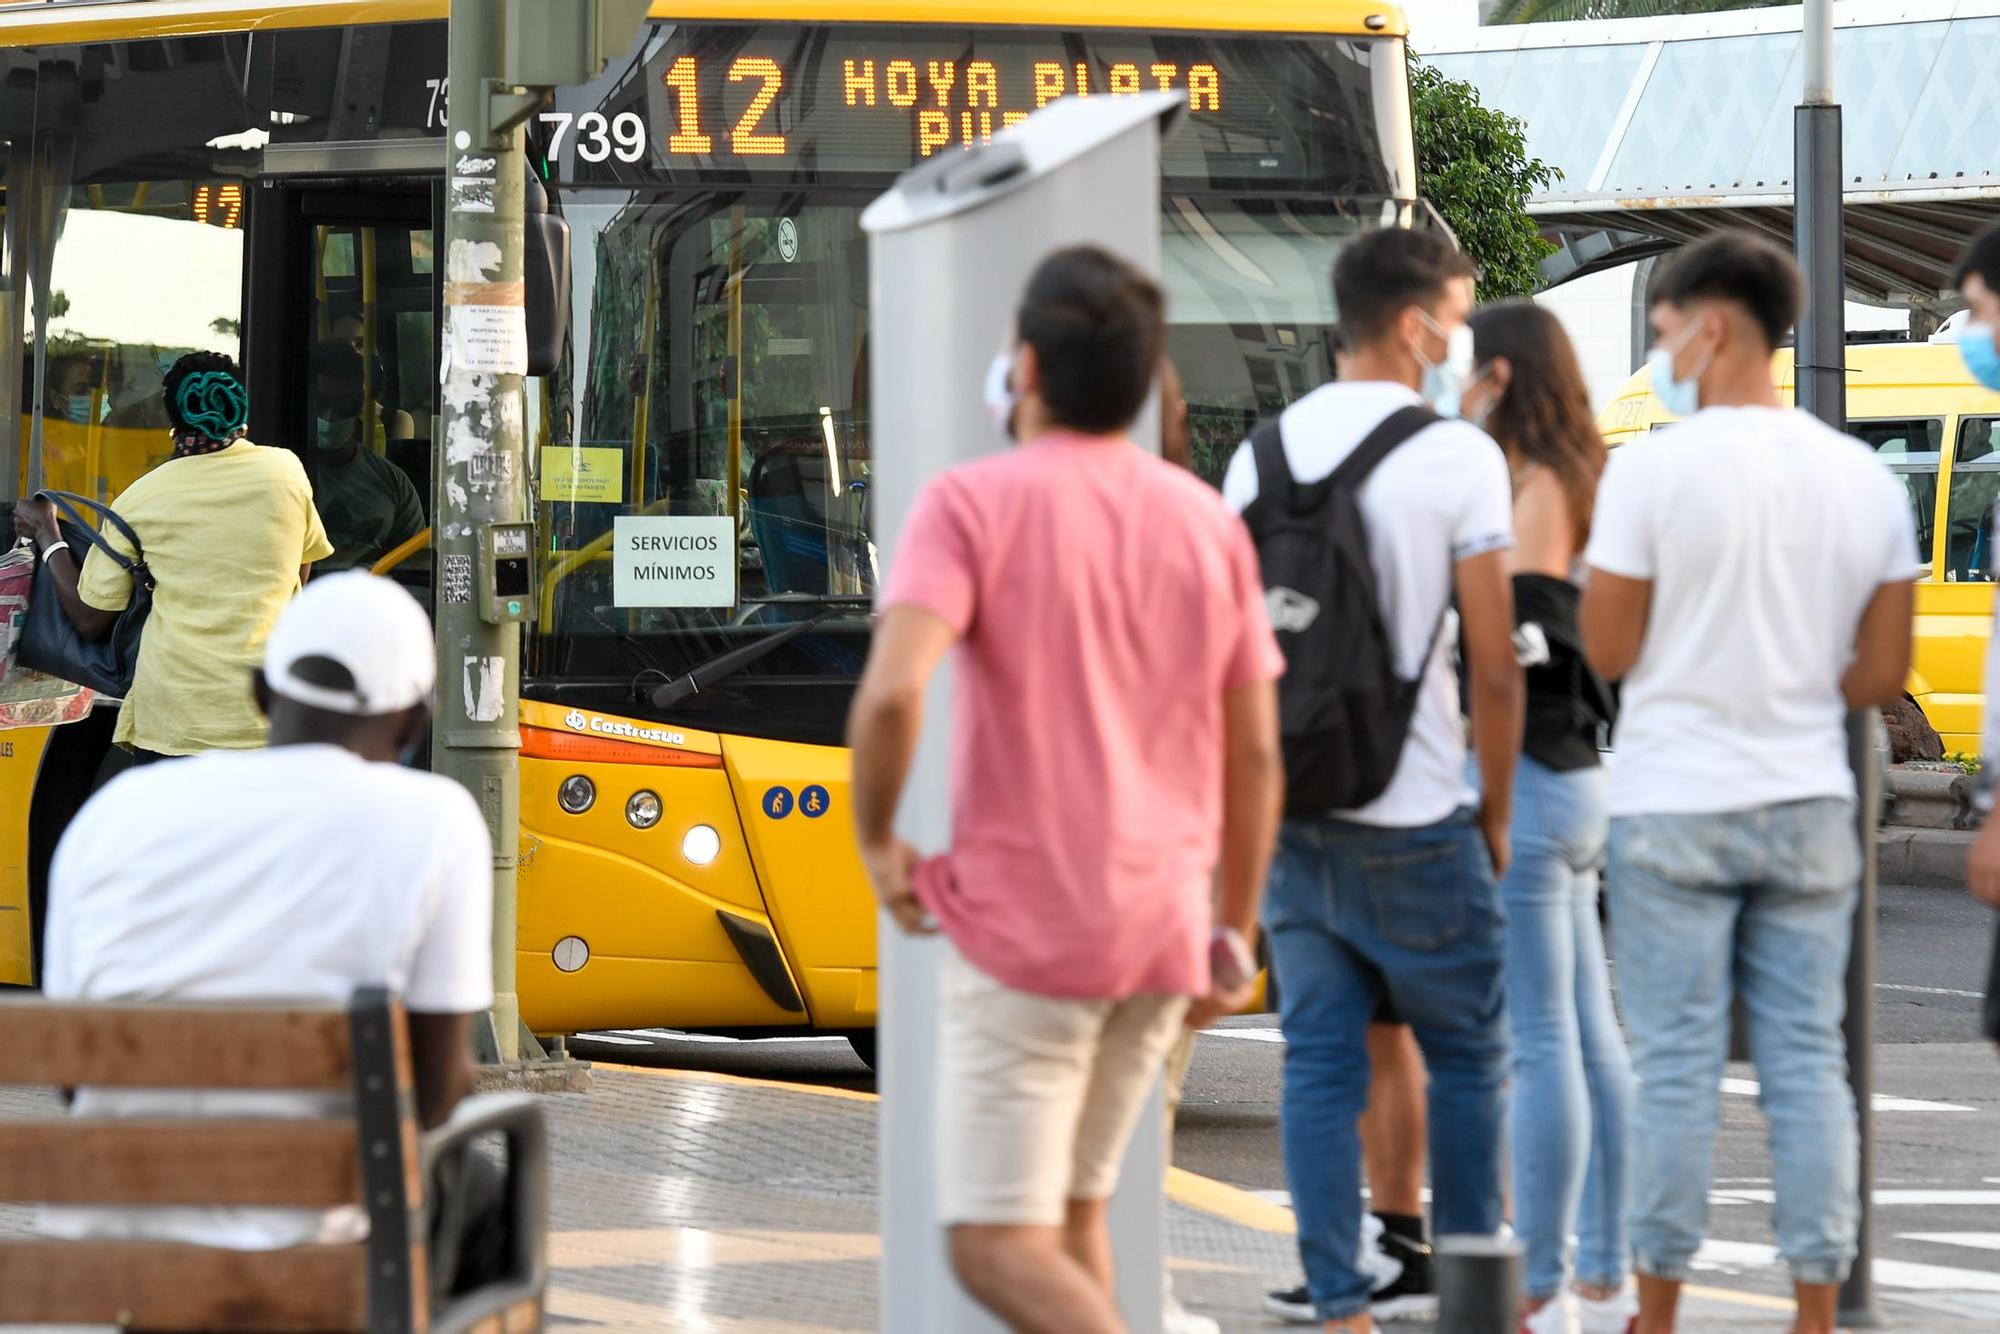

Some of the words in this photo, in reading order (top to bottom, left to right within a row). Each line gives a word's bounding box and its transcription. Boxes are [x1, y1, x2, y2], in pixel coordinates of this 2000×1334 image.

[844, 60, 998, 108] HOYA
[666, 57, 786, 154] 12
[538, 111, 647, 163] 739
[630, 536, 718, 551] SERVICIOS
[633, 561, 716, 581] MÍNIMOS
[589, 716, 685, 745] Castrosua
